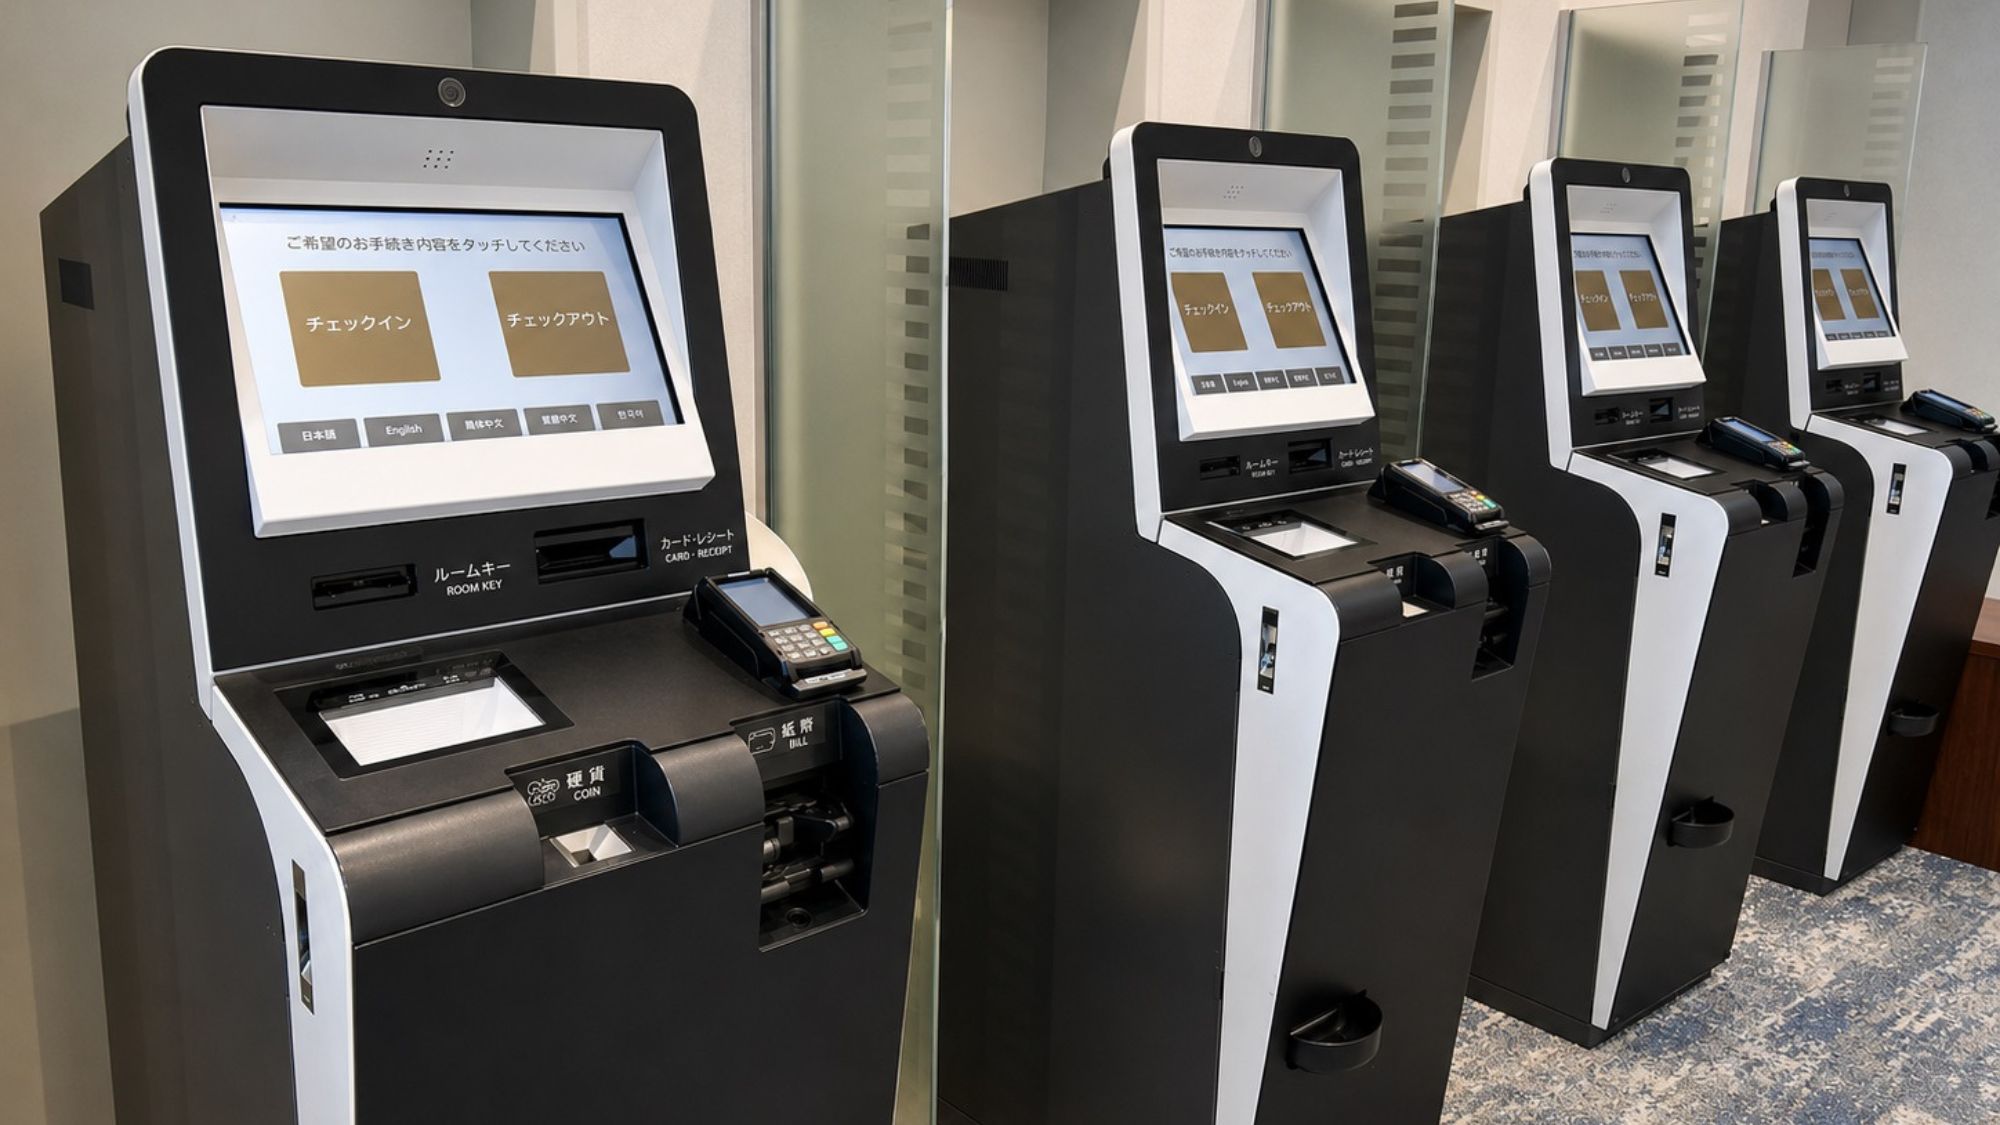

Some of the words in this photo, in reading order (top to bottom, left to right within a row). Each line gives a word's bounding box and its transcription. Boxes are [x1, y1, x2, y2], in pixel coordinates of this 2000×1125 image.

[287, 235, 586, 253] ご希望のお手続き内容をタッチしてください
[305, 313, 412, 333] チェックイン
[506, 311, 609, 328] チェックアウト
[302, 429, 337, 442] 日本語
[385, 424, 423, 437] English
[665, 550, 691, 563] CARD
[698, 545, 733, 559] RECEIPT
[434, 561, 511, 584] ルームキー
[447, 582, 480, 596] ROOM
[482, 579, 503, 592] KEY
[789, 737, 809, 750] BILL
[574, 785, 602, 802] COIN
